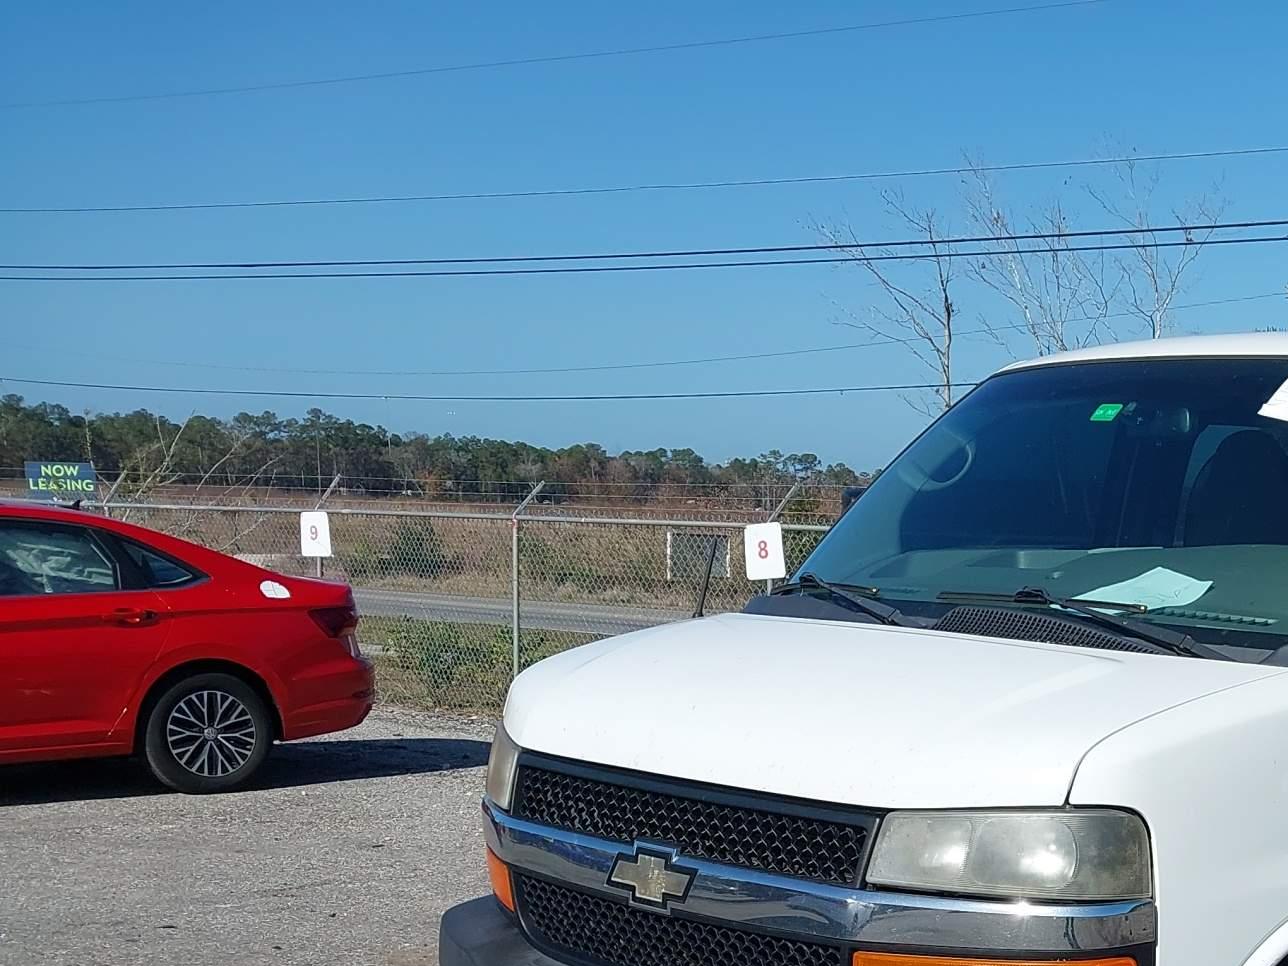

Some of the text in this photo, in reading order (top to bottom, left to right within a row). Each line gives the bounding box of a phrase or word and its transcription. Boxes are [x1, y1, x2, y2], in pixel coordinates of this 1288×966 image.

[40, 464, 79, 477] NOW
[28, 477, 95, 491] LEASING
[310, 525, 318, 541] 9
[758, 540, 769, 559] 8
